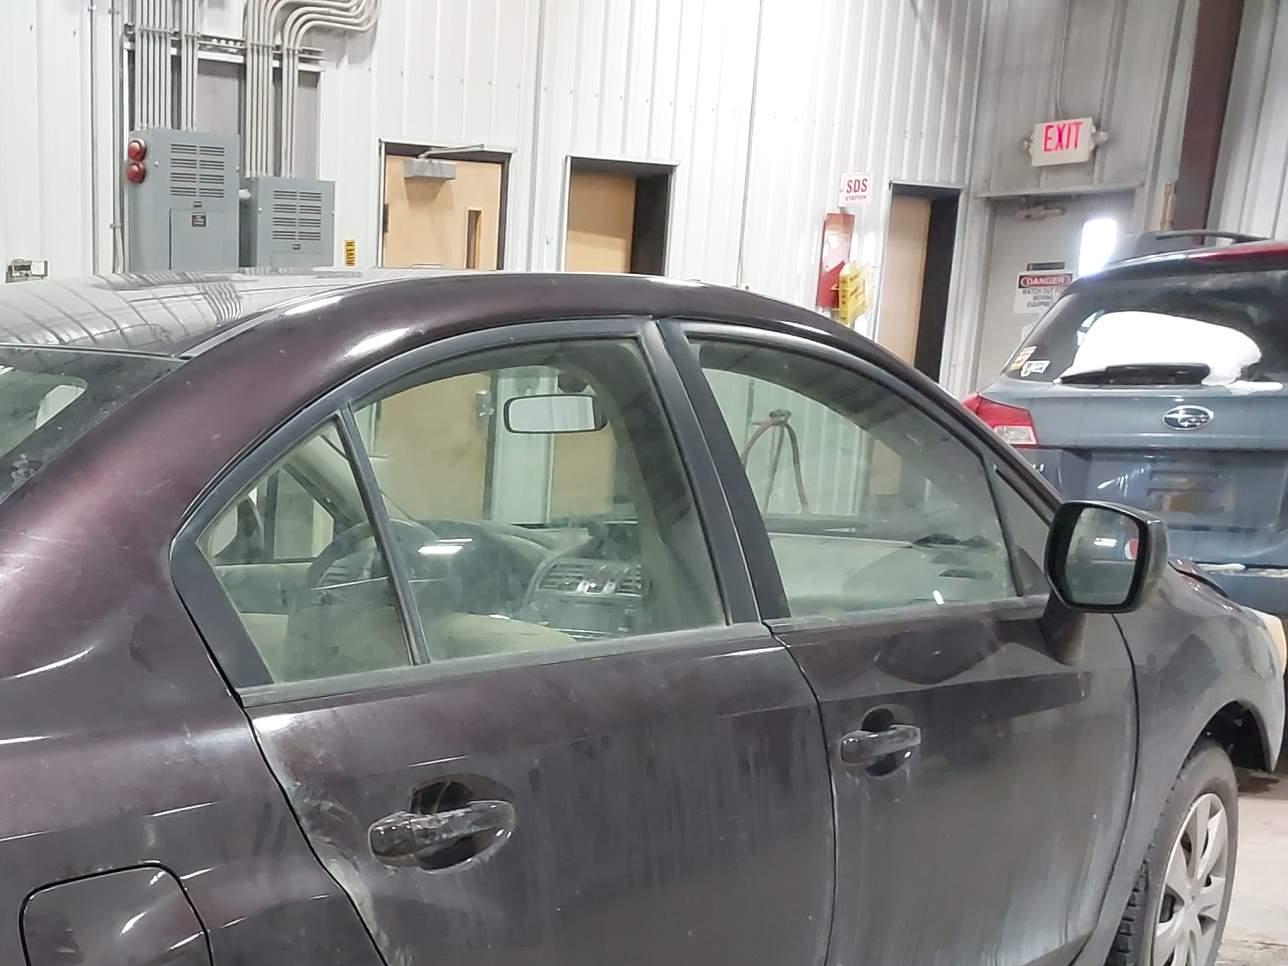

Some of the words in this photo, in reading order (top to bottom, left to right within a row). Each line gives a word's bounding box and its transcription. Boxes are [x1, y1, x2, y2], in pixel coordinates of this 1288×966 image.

[1044, 121, 1082, 152] EXIT
[846, 178, 868, 194] SDS
[1026, 276, 1065, 286] DANGER
